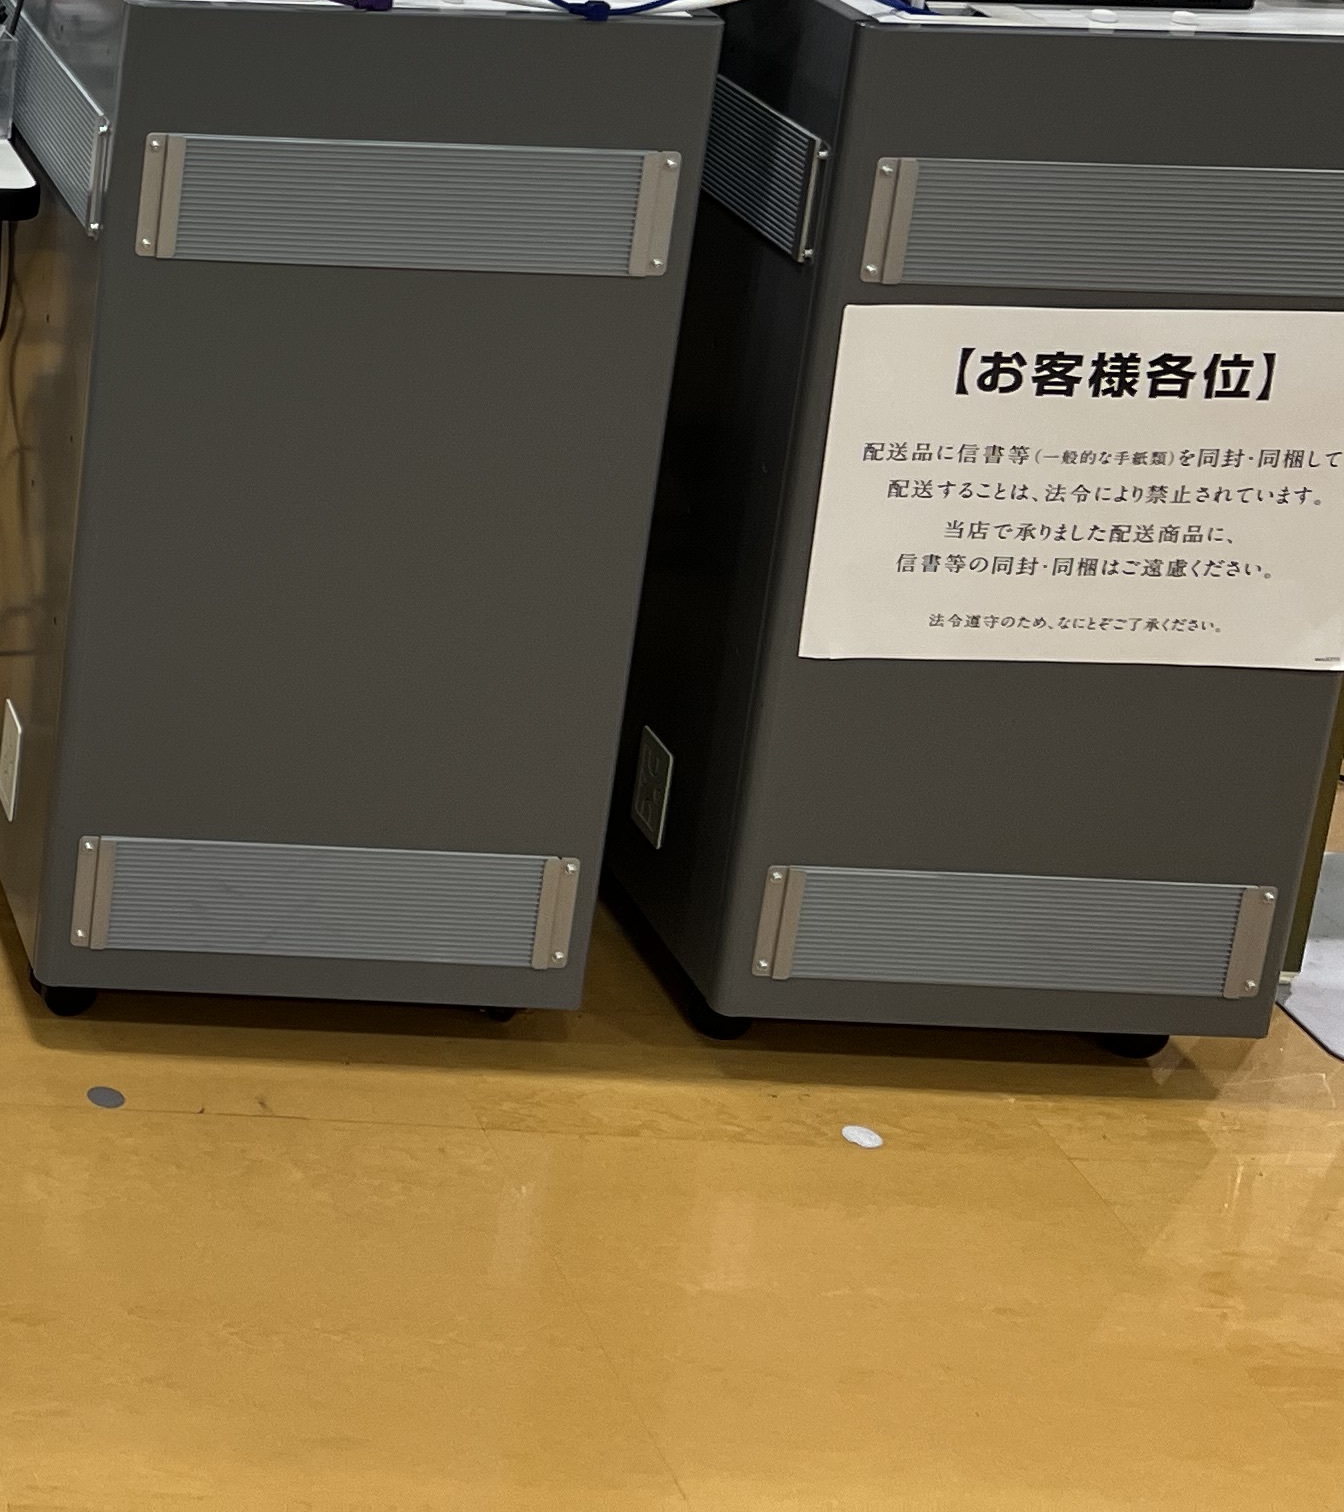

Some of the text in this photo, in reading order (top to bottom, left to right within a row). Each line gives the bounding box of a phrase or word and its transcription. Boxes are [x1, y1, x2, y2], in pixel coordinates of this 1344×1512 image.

[955, 347, 1277, 401] 【お客様各位】
[886, 479, 1322, 507] 配送することは、法令により禁止されています。
[943, 520, 1236, 545] 当店で承りました配送商品に、
[895, 552, 1273, 580] 信書等の同封・同梱はご遠慮ください。
[928, 613, 1223, 634] 法令遵守のため、なにとぞご了承ください。
